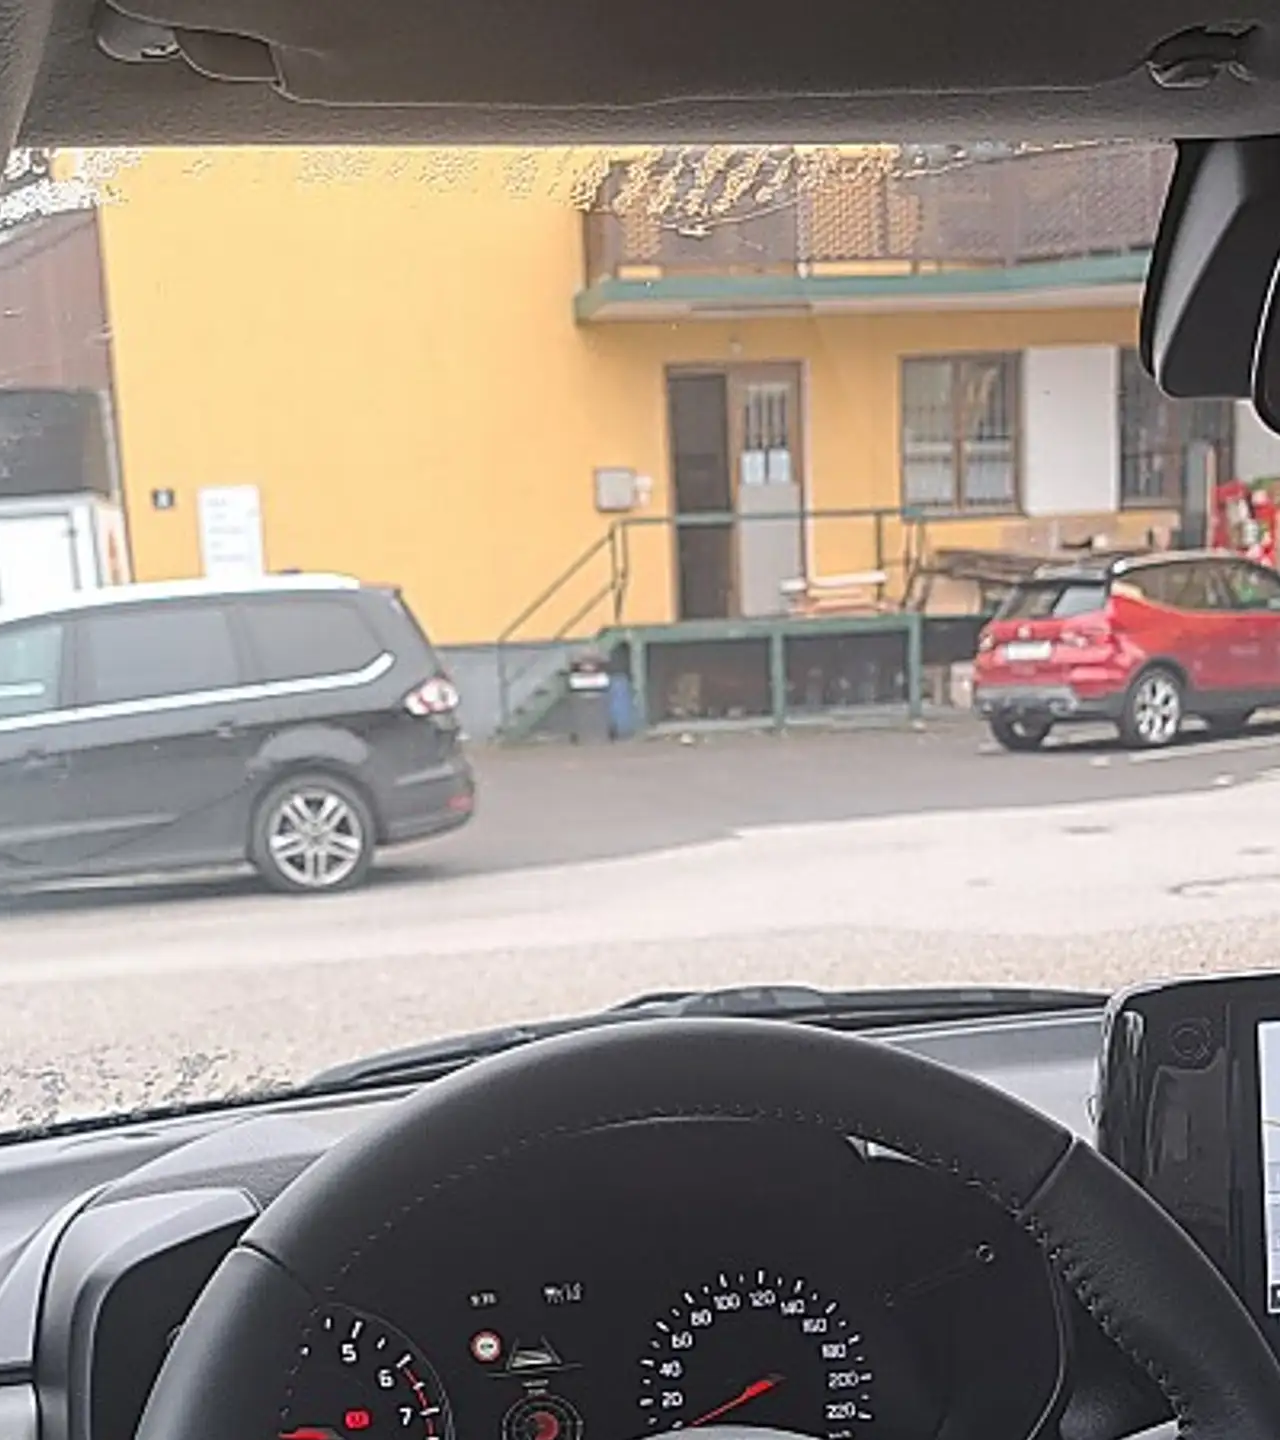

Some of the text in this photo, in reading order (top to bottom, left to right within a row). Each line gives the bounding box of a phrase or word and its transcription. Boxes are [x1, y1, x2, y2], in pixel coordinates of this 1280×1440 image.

[714, 1293, 741, 1310] 100
[749, 1289, 776, 1307] 120
[780, 1299, 805, 1315] 140
[691, 1309, 712, 1326] 80
[672, 1331, 693, 1348] 60
[341, 1343, 358, 1362] 5
[659, 1360, 682, 1377] 40
[378, 1368, 395, 1388] 6
[828, 1371, 858, 1389] 200
[662, 1392, 683, 1408] 20
[399, 1407, 412, 1426] 7
[826, 1402, 856, 1420] 220
